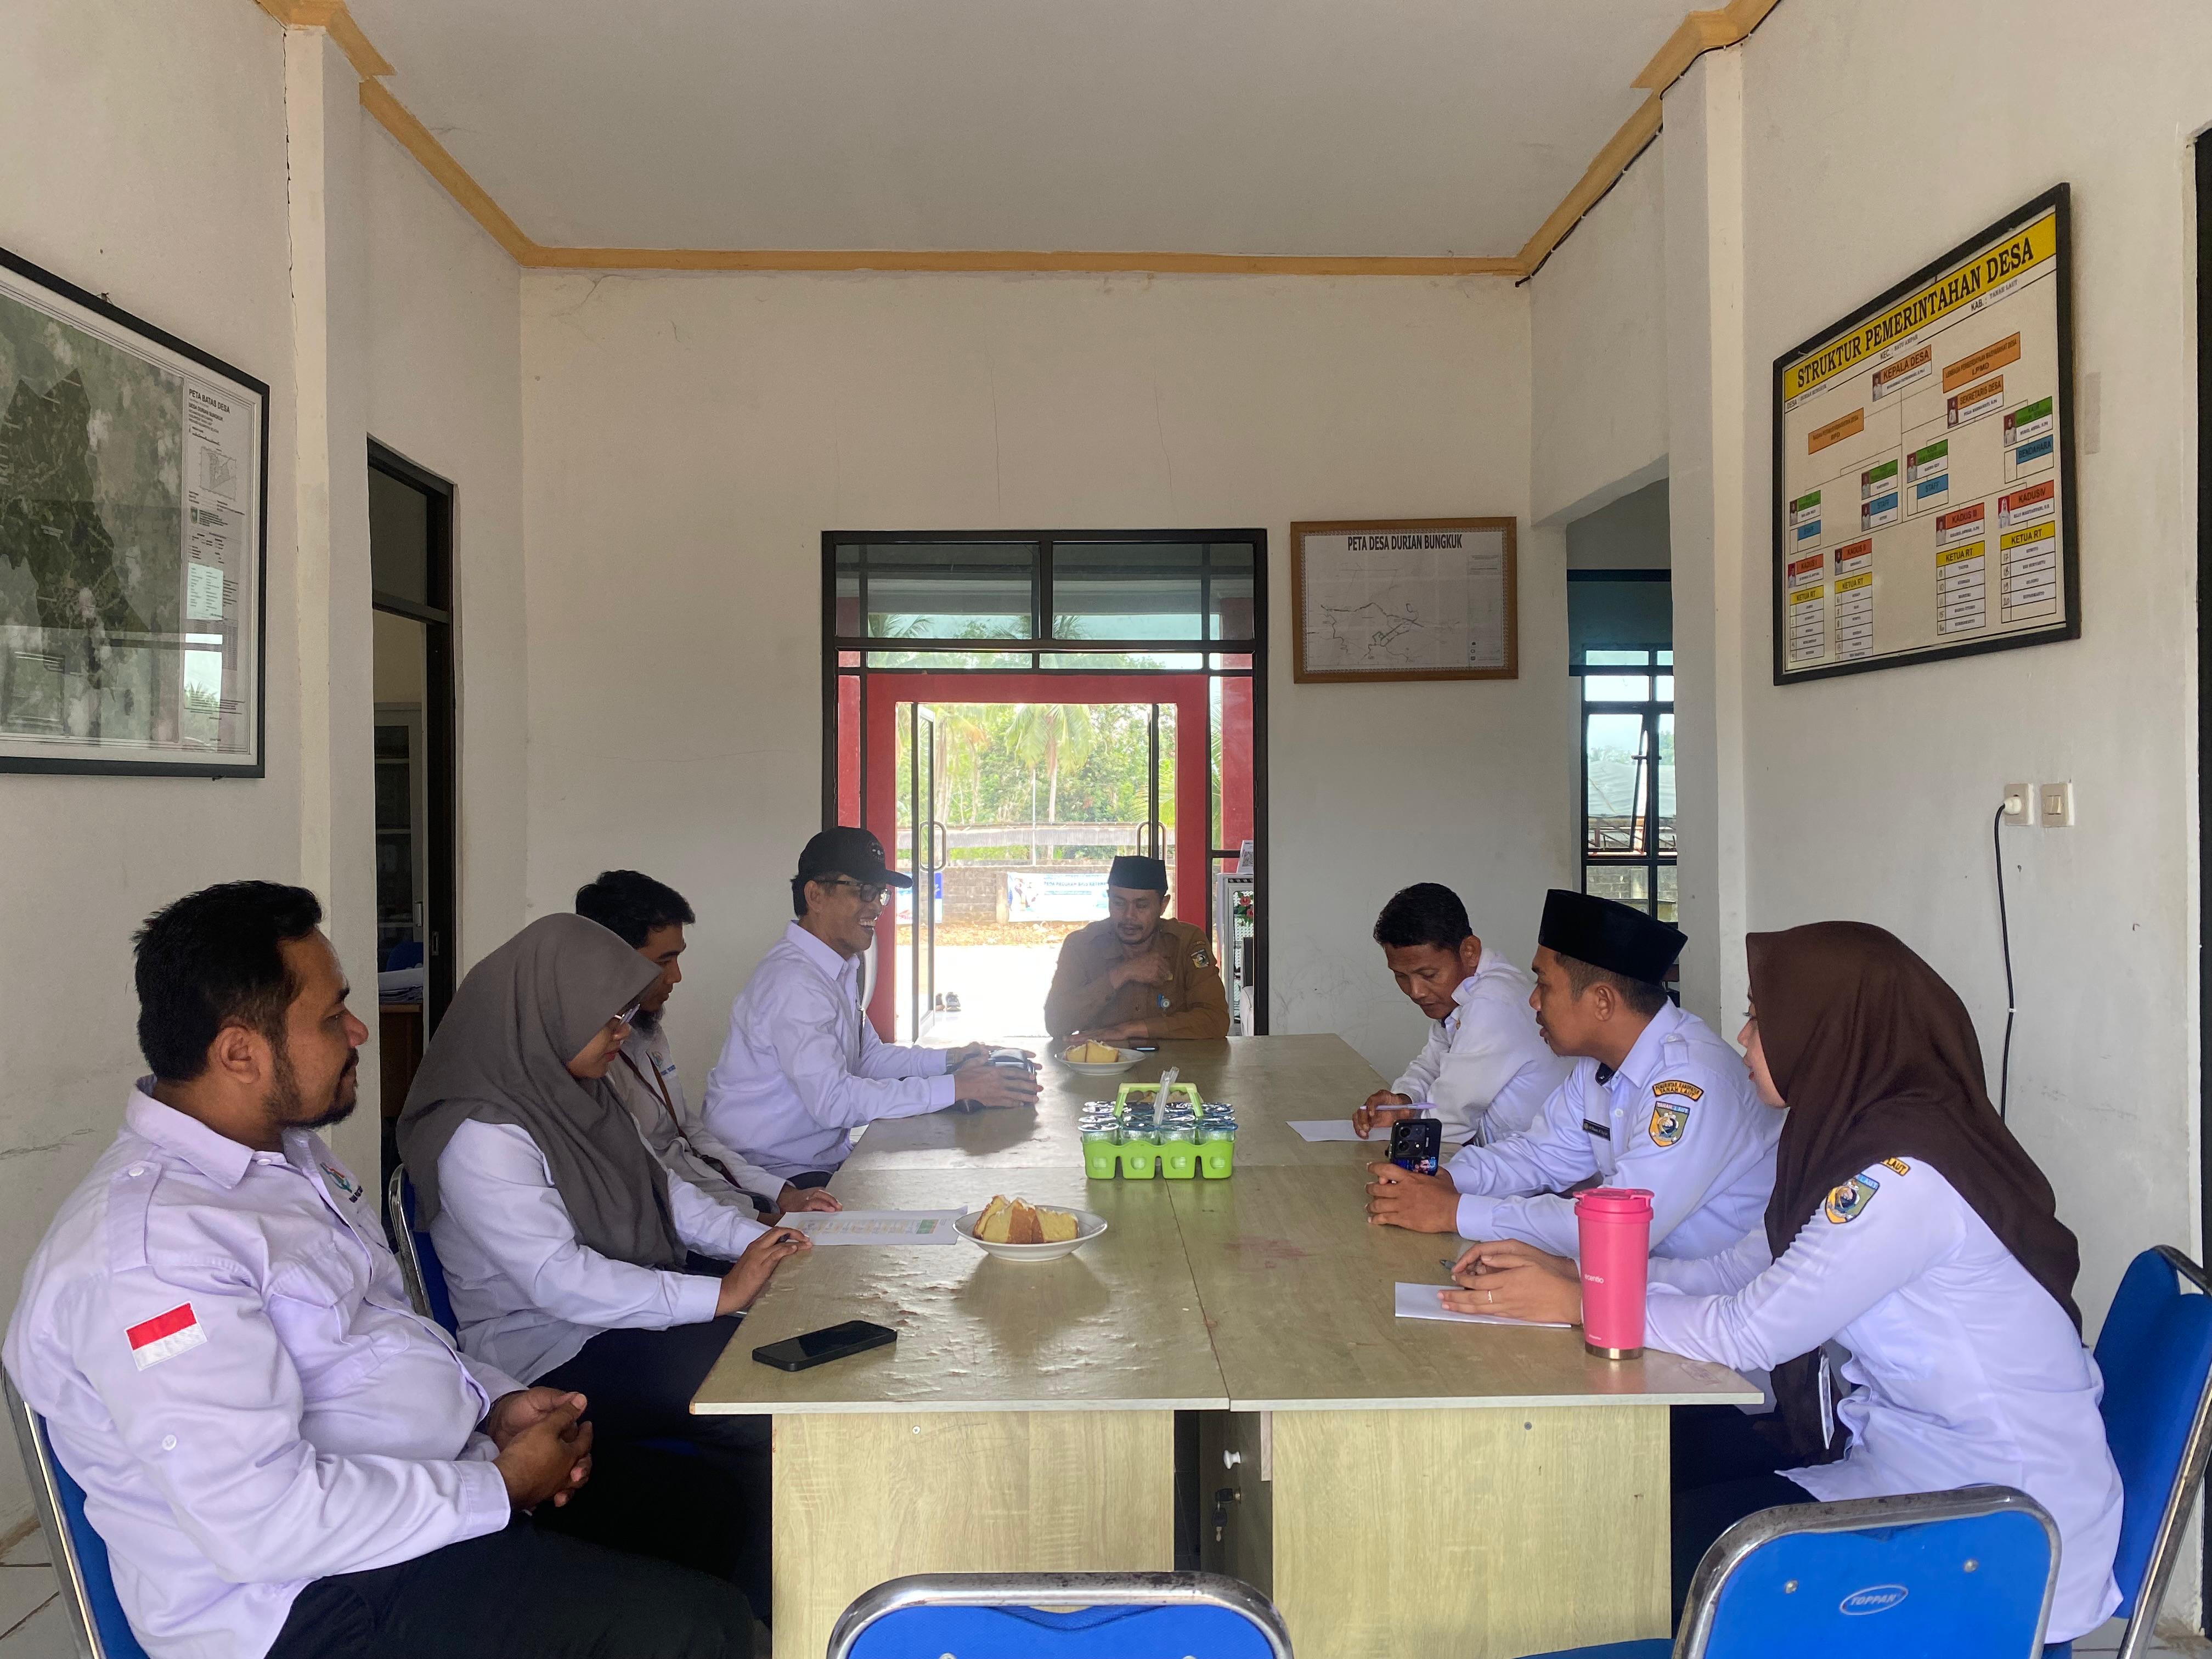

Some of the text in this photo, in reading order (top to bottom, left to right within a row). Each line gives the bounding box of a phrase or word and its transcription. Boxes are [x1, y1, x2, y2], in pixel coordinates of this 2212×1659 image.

[1989, 279, 2018, 300] TANAH LAUT
[1798, 336, 1861, 388] STRUKTUR
[1865, 265, 1981, 351] PEMERINTAHAN
[1987, 236, 2034, 284] DESA
[1883, 360, 1909, 380] KEPALA
[1910, 349, 1929, 369] DESA
[1972, 362, 1989, 375] LPMD
[1960, 380, 2001, 405] SEKRETARIS DESA
[189, 388, 230, 414] PETA BATAS DESA
[1787, 399, 1797, 409] DESA
[2019, 441, 2051, 459] BENDAHARA
[1926, 481, 1940, 493] STAFF
[2019, 489, 2040, 503] KADUS
[1952, 511, 1972, 523] KADUS
[1347, 534, 1463, 551] PETA DESA DURIAN BUNGKUK
[2011, 529, 2042, 545] KETUA RT
[1847, 544, 1863, 555] KADUS
[1945, 549, 1973, 562] KETUA RT
[1842, 578, 1864, 589] KETUA RT
[1797, 593, 1810, 601] KETUA
[1680, 1087, 1694, 1097] LAUT
[1887, 1158, 1907, 1173] LAUT
[1851, 1594, 1897, 1605] TOPPAN
